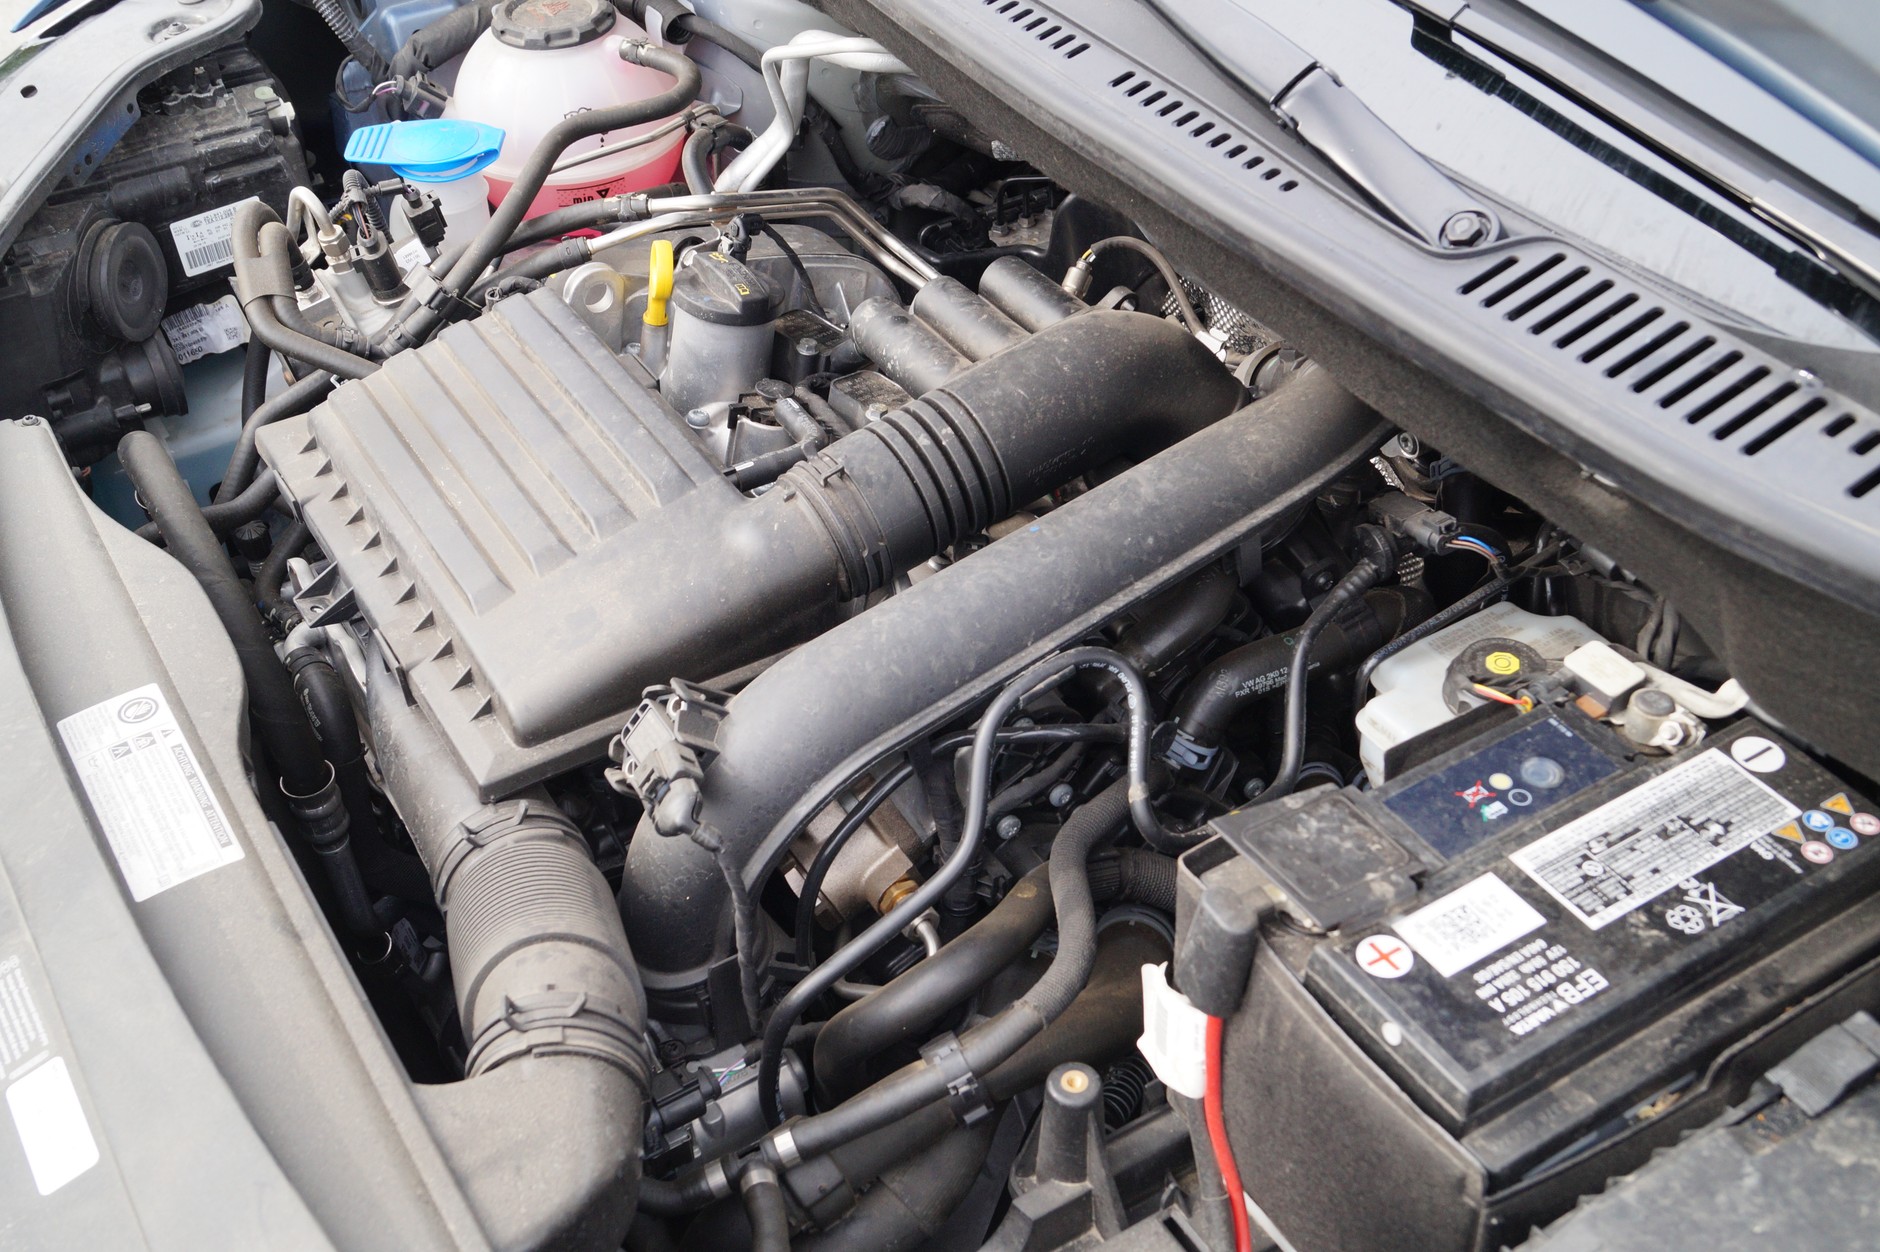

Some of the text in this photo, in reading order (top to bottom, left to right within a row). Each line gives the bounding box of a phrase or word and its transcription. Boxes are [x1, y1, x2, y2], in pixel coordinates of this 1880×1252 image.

[572, 193, 594, 204] min
[172, 744, 230, 845] ACHTUNG WARNING ATTENTION
[1488, 997, 1506, 1013] A
[1509, 967, 1609, 1035] EFB VARTA
